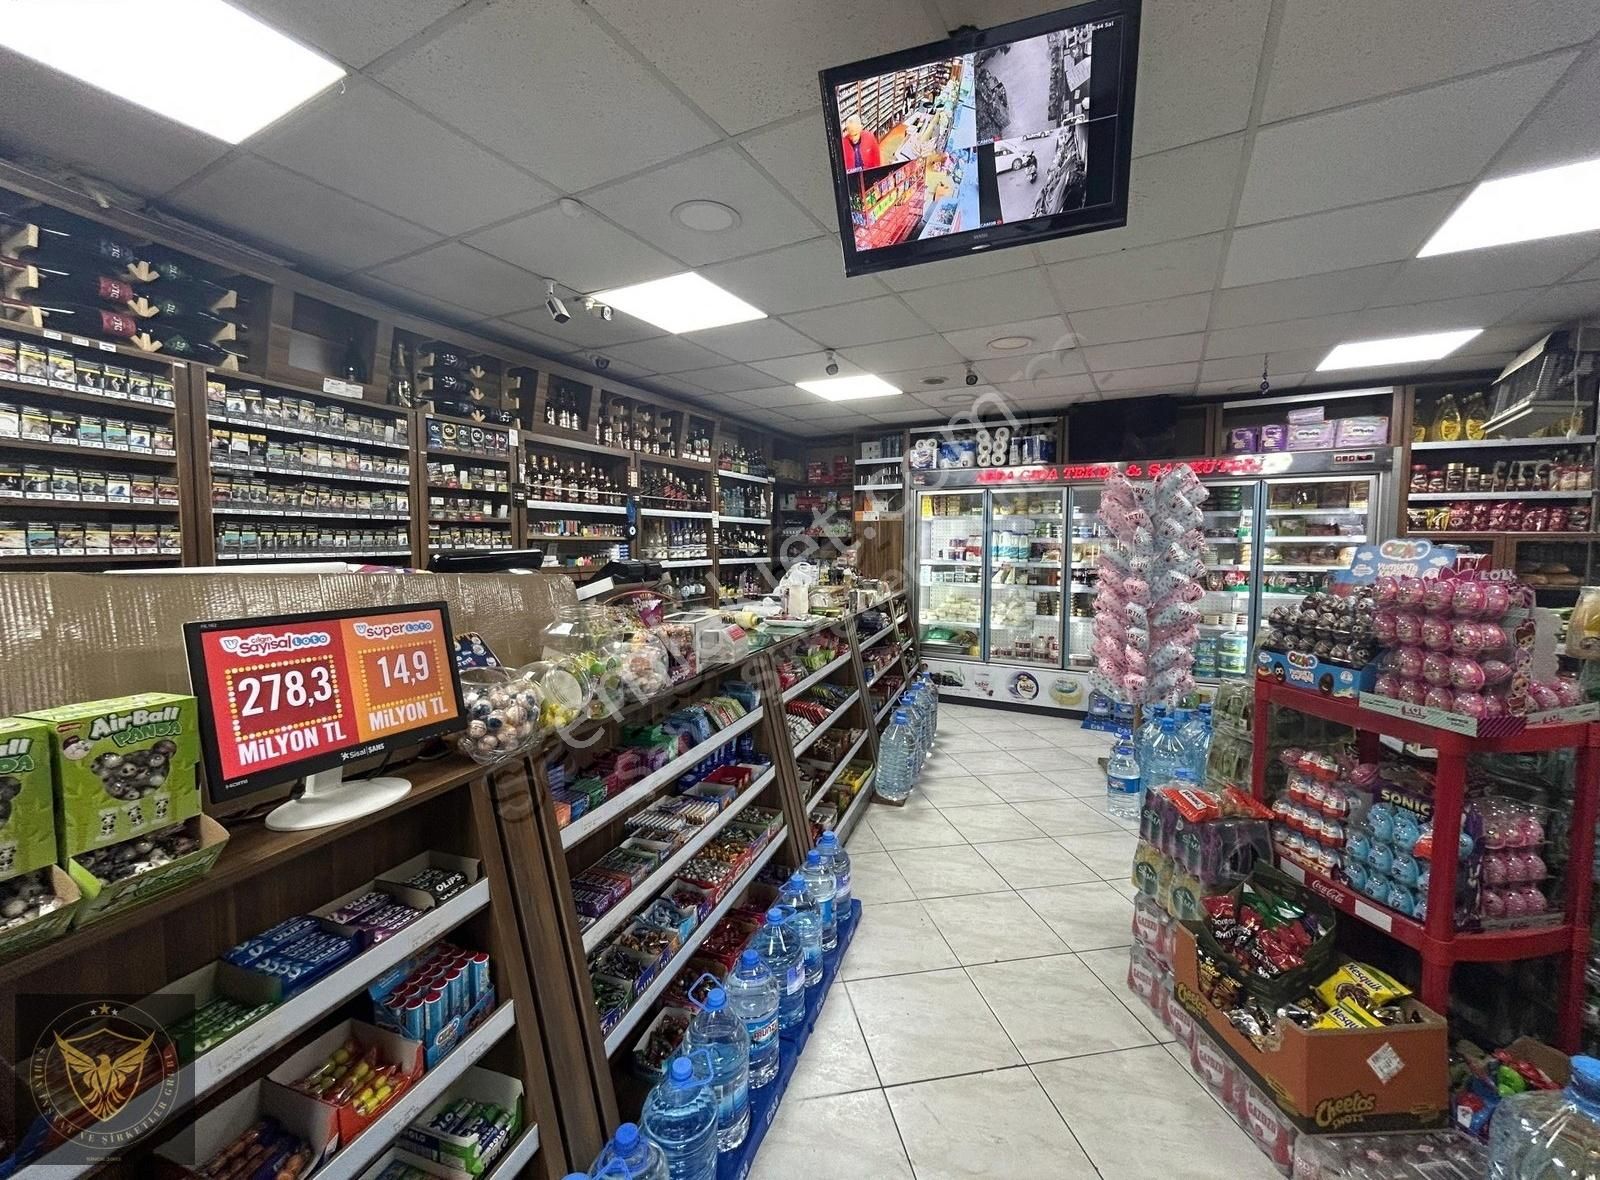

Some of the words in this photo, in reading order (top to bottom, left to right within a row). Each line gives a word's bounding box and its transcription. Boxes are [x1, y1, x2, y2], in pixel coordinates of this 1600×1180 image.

[1063, 463, 1110, 479] TEKE
[1126, 465, 1142, 477] &
[366, 624, 405, 638] süper
[377, 651, 429, 688] 14,9
[238, 667, 332, 717] 278,3
[429, 697, 448, 714] TL
[91, 707, 181, 740] AirBall
[112, 721, 182, 748] PANDA
[322, 721, 347, 742] TL
[0, 754, 35, 774] DA
[1381, 790, 1430, 816] SONIC
[436, 872, 462, 892] OLIPS
[1347, 962, 1382, 992] Nesquik
[1315, 1091, 1376, 1128] Cheetos
